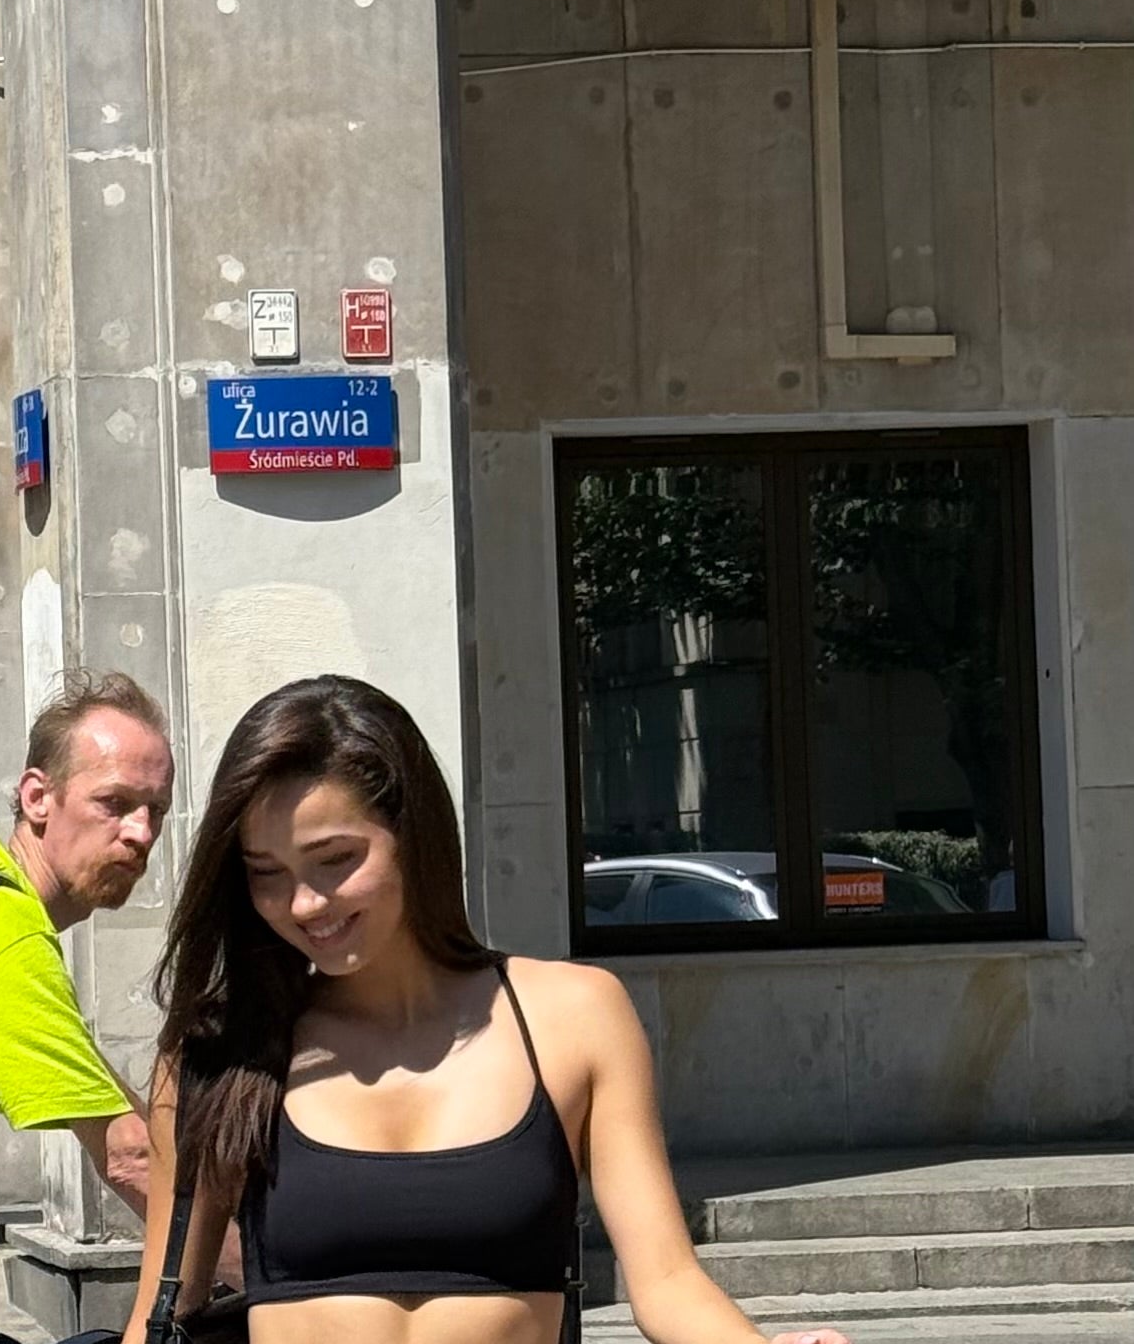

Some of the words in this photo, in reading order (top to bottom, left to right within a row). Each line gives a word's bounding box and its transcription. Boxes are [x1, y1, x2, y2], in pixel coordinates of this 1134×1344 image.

[253, 300, 266, 319] Z
[346, 297, 359, 318] H
[222, 382, 256, 399] ulica
[234, 398, 369, 440] Żurawia
[249, 449, 333, 469] Śródmieście
[338, 451, 360, 467] Pd.
[826, 882, 883, 896] HUNTERS
